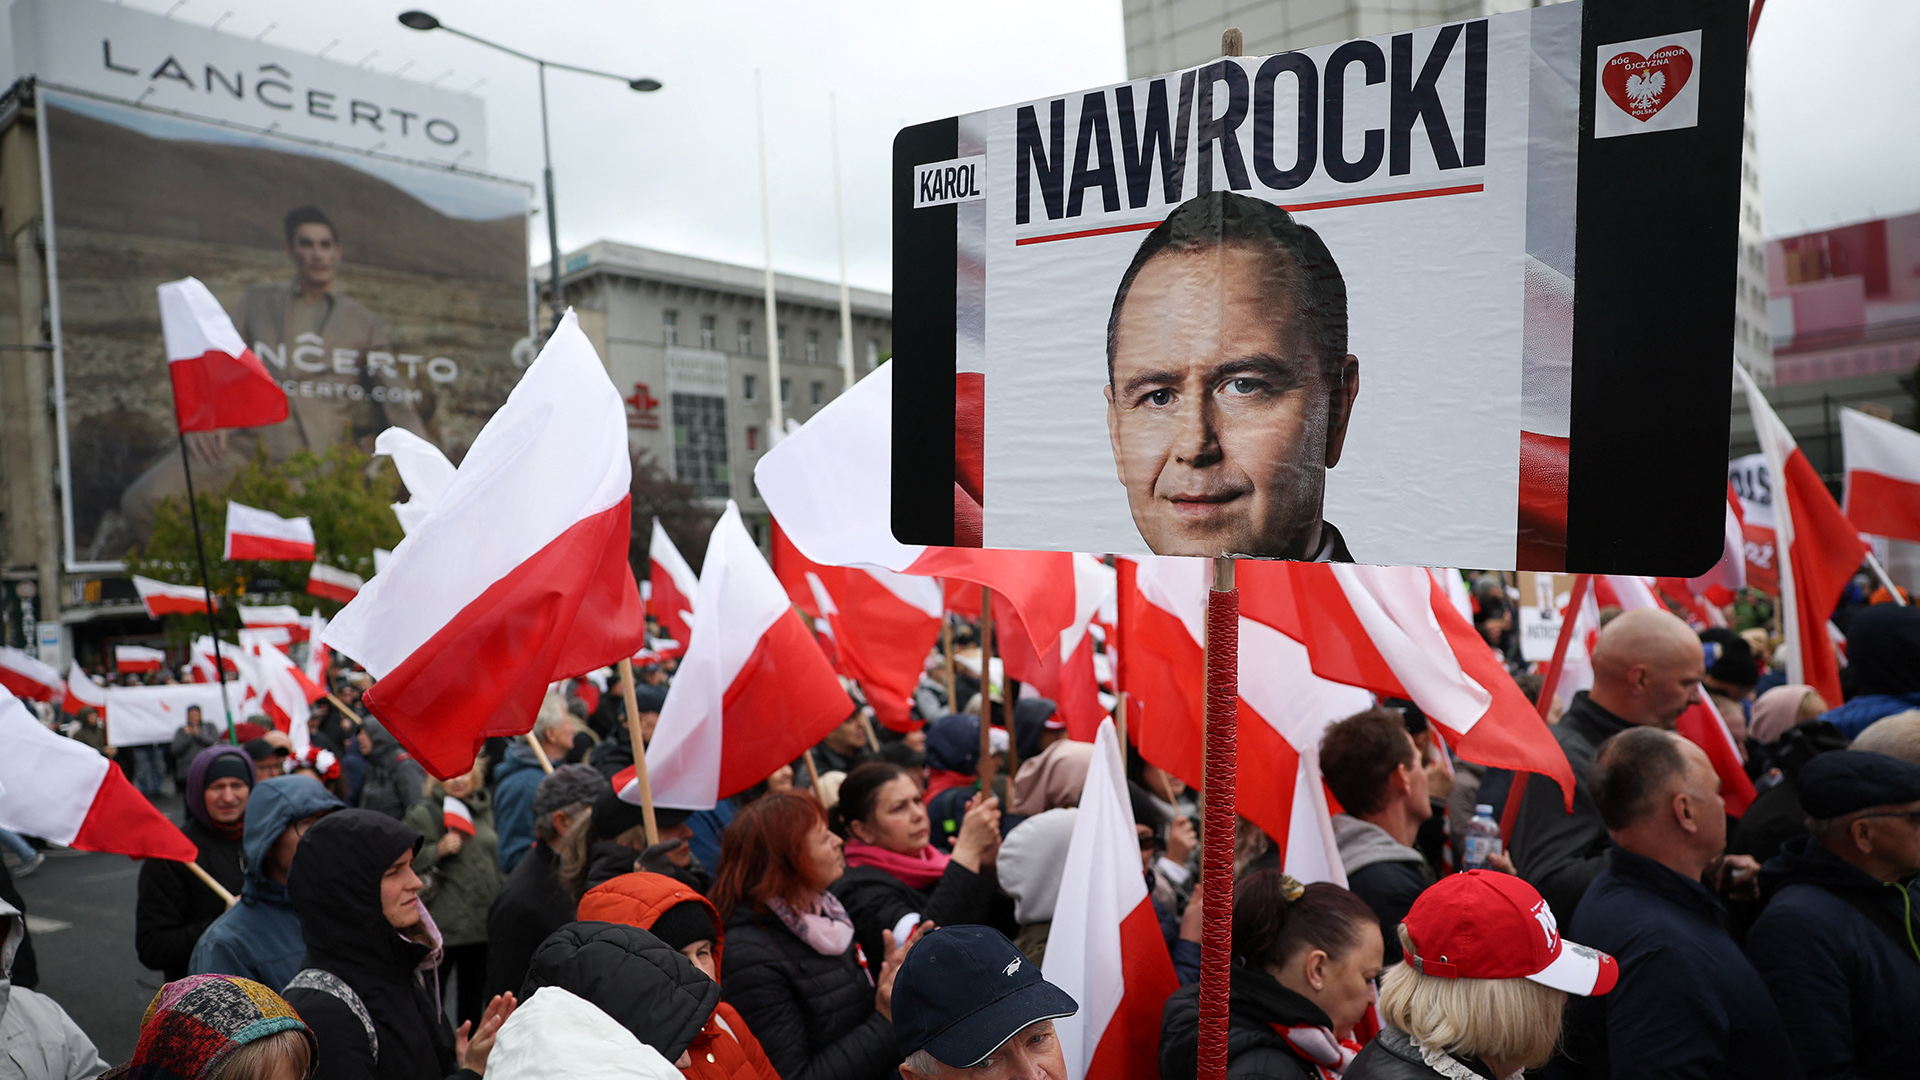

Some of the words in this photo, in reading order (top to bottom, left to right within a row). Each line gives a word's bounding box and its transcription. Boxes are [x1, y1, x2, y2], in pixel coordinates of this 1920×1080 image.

[1611, 56, 1630, 66] BÓG
[1652, 48, 1686, 60] HONOR
[1624, 58, 1670, 71] OJCZYZNA
[1015, 20, 1489, 225] NAWROCKI
[1631, 108, 1658, 116] POLSKA
[920, 164, 980, 202] KAROL
[253, 331, 459, 382] NĈERTO
[280, 379, 423, 404] CERTO.COM
